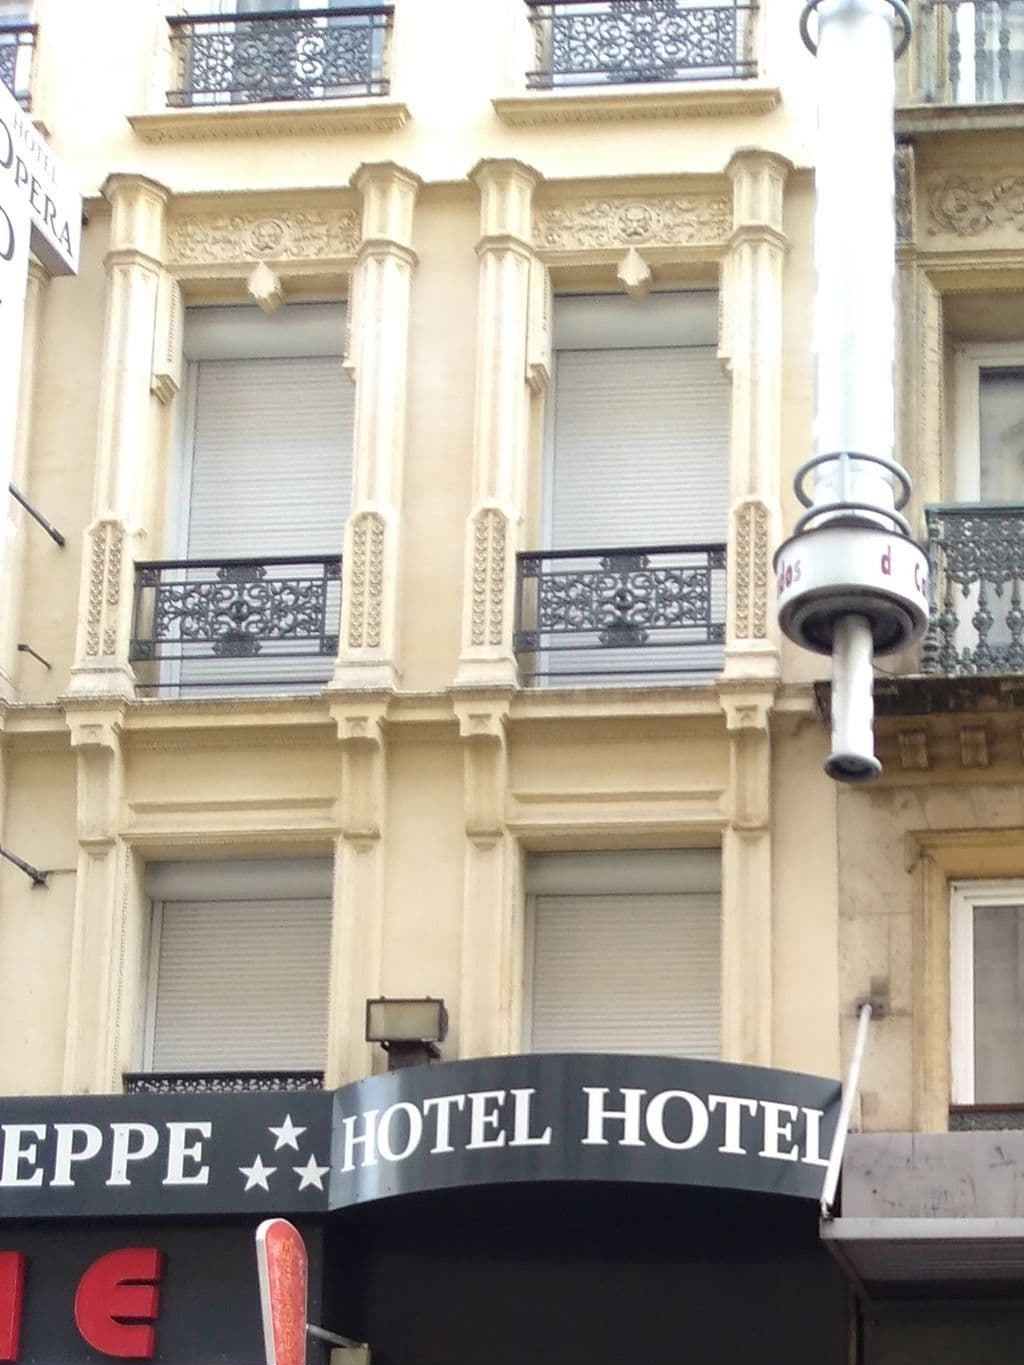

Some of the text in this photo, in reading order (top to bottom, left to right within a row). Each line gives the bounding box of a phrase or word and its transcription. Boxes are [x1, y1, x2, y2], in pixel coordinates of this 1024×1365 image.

[14, 113, 58, 186] HOTEL
[340, 1086, 833, 1172] HOTEL HOTEL
